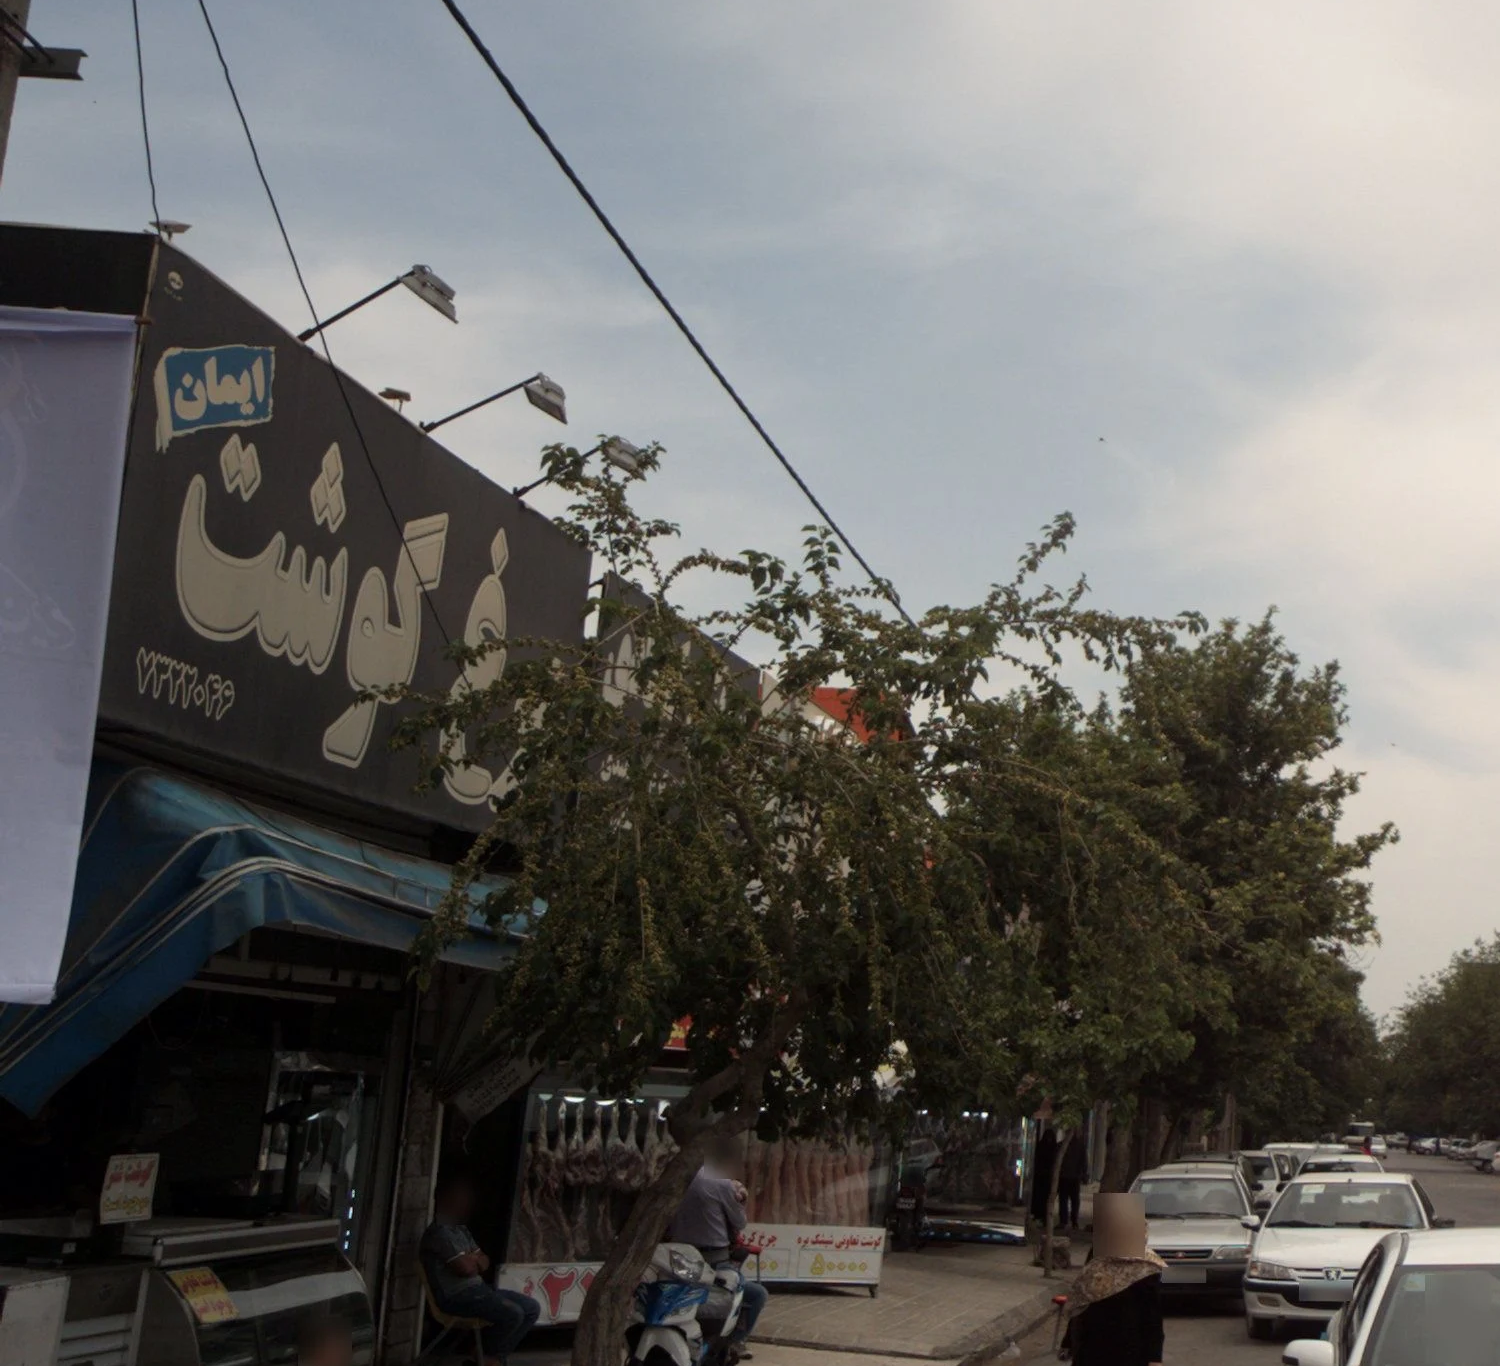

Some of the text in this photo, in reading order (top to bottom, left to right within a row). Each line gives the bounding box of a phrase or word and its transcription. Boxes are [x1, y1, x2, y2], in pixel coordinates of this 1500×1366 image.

[173, 355, 267, 422] ایمان
[175, 432, 556, 817] رغ گوشت
[834, 1235, 860, 1250] تعاونی
[860, 1236, 882, 1251] گوشت
